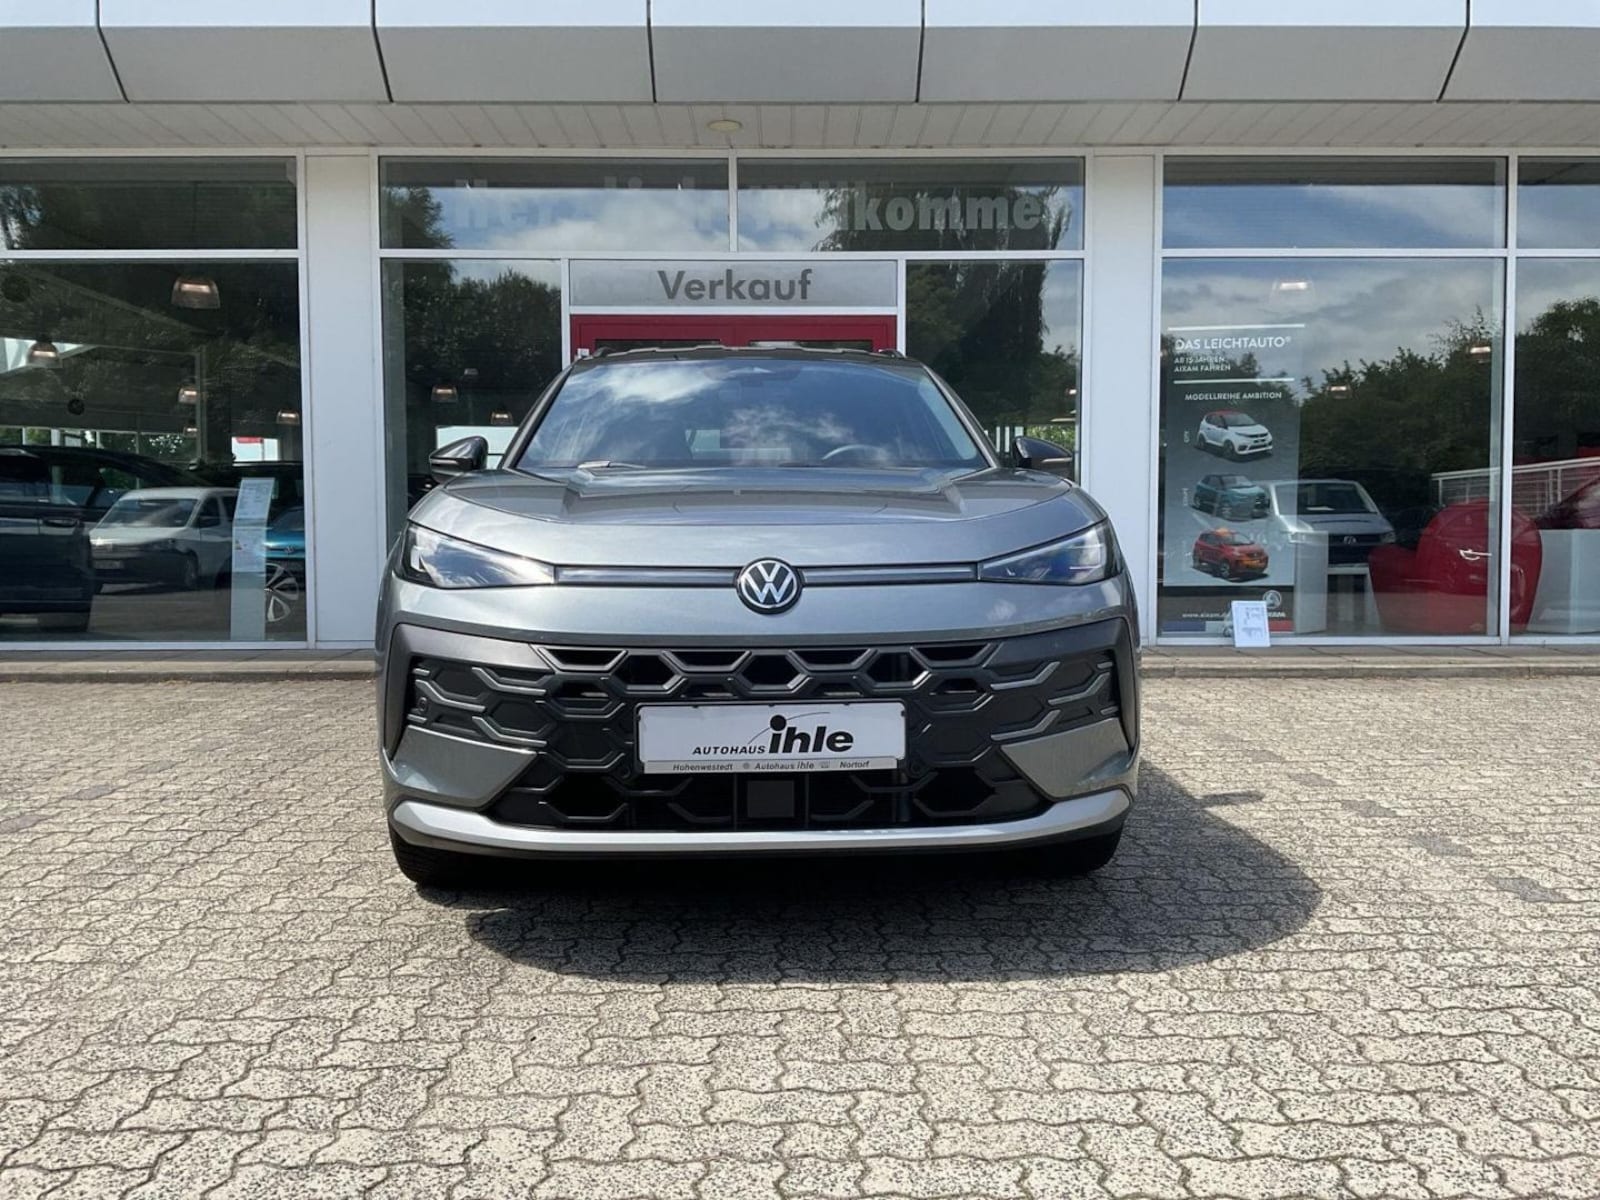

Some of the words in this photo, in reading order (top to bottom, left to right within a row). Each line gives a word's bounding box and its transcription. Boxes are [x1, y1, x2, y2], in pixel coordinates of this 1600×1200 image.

[657, 269, 813, 300] Verkauf
[1175, 339, 1201, 350] DAS
[1185, 391, 1241, 401] MODELLREIHE
[1242, 391, 1282, 400] AMBITION
[738, 559, 798, 609] VW
[692, 745, 767, 756] AUTOHAUS
[768, 714, 854, 754] ihle
[672, 762, 734, 771] Hohenwestedt
[754, 762, 795, 771] Autohaus
[840, 760, 870, 769] Nortorf
